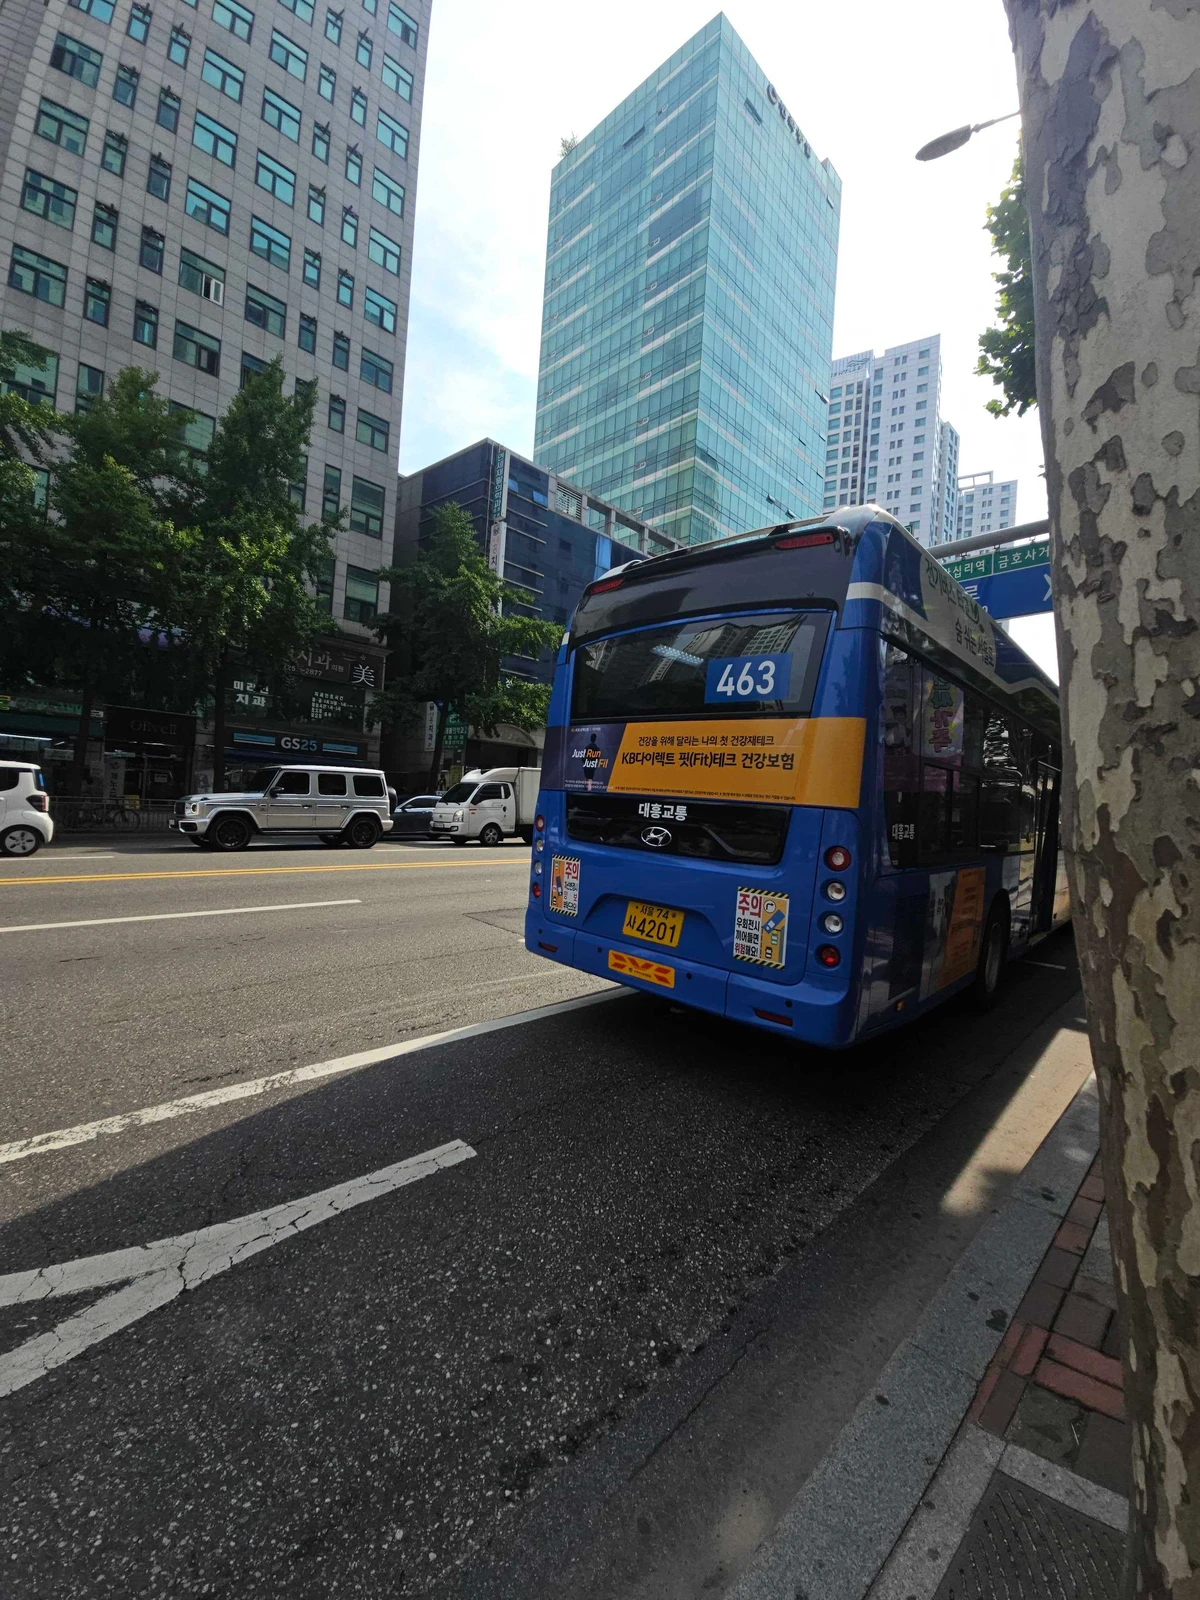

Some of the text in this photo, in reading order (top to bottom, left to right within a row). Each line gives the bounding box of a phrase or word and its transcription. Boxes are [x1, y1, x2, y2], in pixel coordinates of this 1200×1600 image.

[351, 663, 375, 688] 美
[716, 660, 775, 697] 463
[235, 693, 267, 707] 치과
[280, 736, 318, 752] GS25
[638, 735, 774, 746] 건강을 위해 달리는 나의 첫 건강재테크
[571, 748, 601, 758] Just Run
[621, 752, 794, 770] KB다이렉트 핏(Fit)테크 건강보험
[583, 758, 609, 768] Just Fit
[638, 802, 688, 821] 대흥교통
[891, 823, 915, 840] 대흥교통
[565, 861, 579, 881] 주의
[640, 904, 670, 920] 서울 74
[738, 893, 762, 918] 주의
[736, 917, 760, 932] 우회전시
[735, 930, 759, 945] 끼어들면
